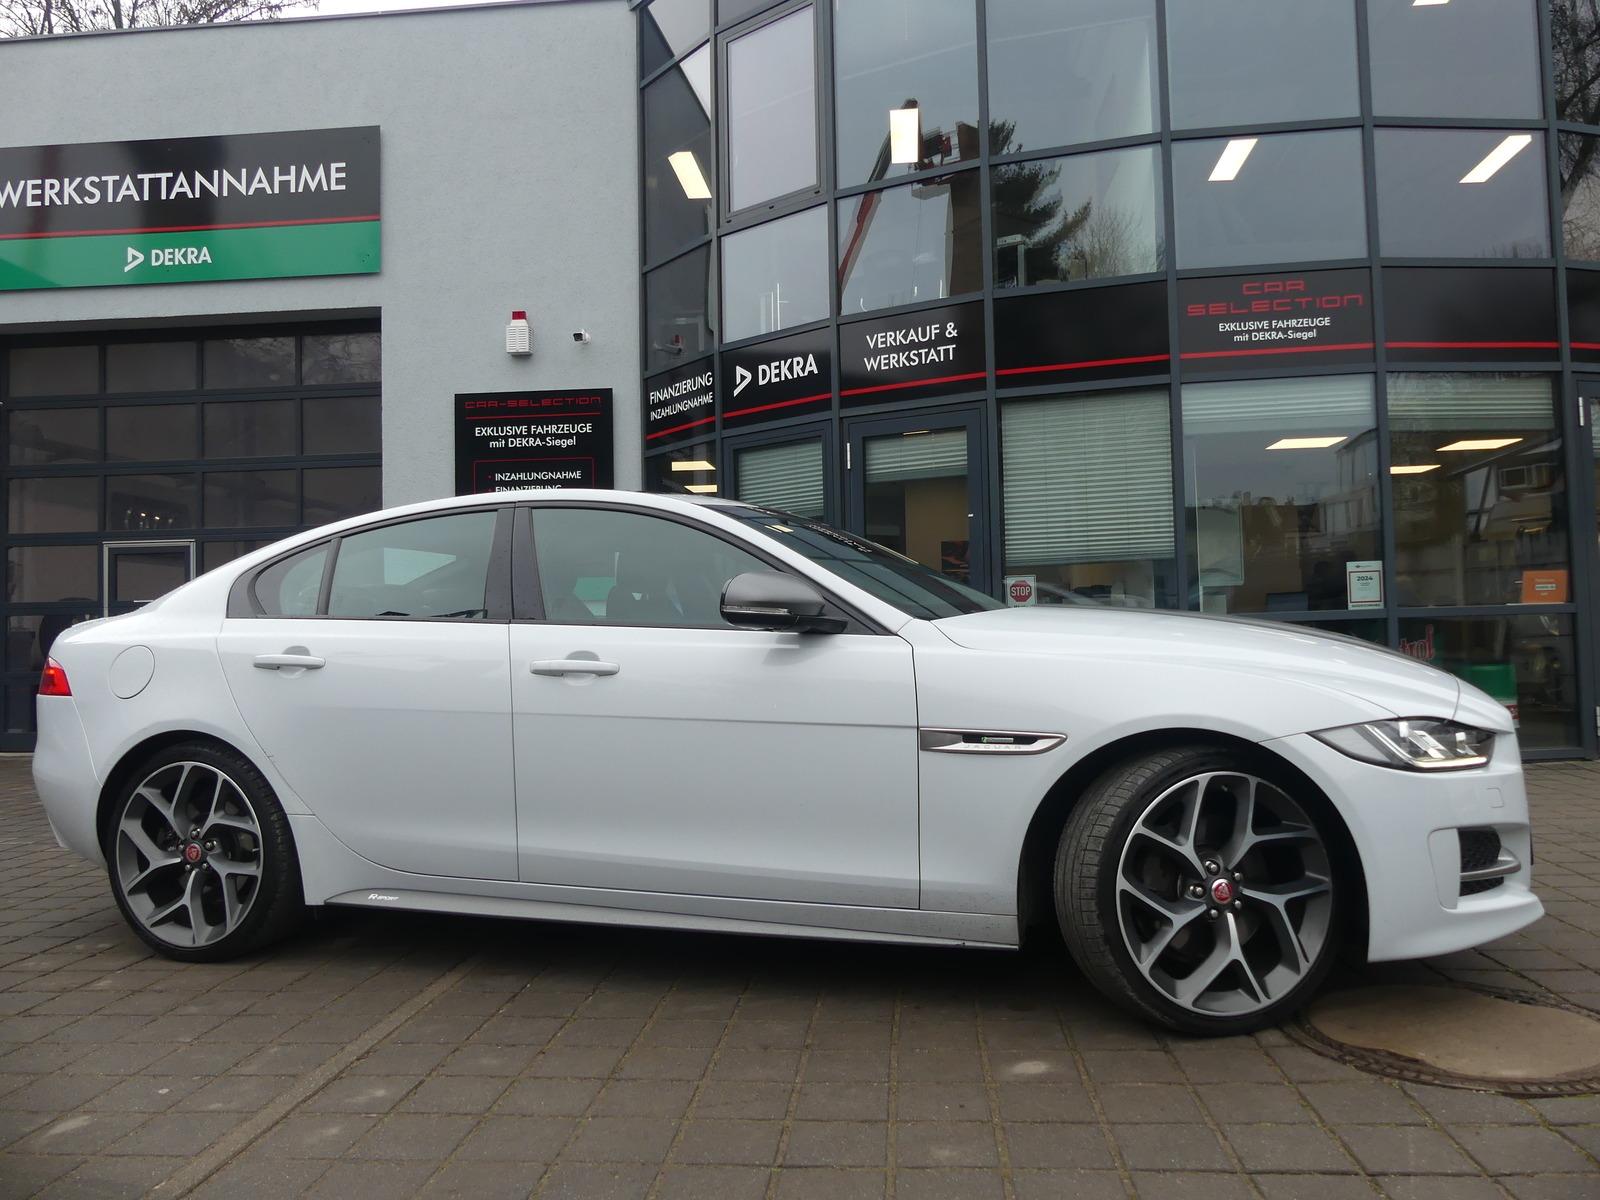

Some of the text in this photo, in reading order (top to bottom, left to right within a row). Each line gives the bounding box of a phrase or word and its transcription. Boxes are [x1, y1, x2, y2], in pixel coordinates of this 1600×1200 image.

[0, 162, 346, 209] WERKSTATTANNAHME
[151, 246, 212, 266] DEKRA
[1242, 280, 1305, 295] CAR
[1187, 294, 1364, 317] SELECTION
[1218, 317, 1331, 332] EXKLUSIVE FAHRZEUGE
[866, 322, 958, 349] VERKAUF &
[1233, 329, 1317, 342] mit DEKRA-Siegel
[864, 345, 956, 371] WERKSTATT
[758, 353, 818, 386] DEKRA
[650, 371, 713, 405] FINANZIERUNG
[464, 397, 602, 409] CAR-SELECTION
[650, 391, 713, 421] INZAHLUNGNAHME
[475, 423, 593, 437] EXKLUSIVE FAHRZEUGE
[489, 436, 576, 448] mit DEKRA-Siegel
[495, 471, 582, 481] INZAHLUNGNAHME
[1011, 586, 1031, 597] STOP
